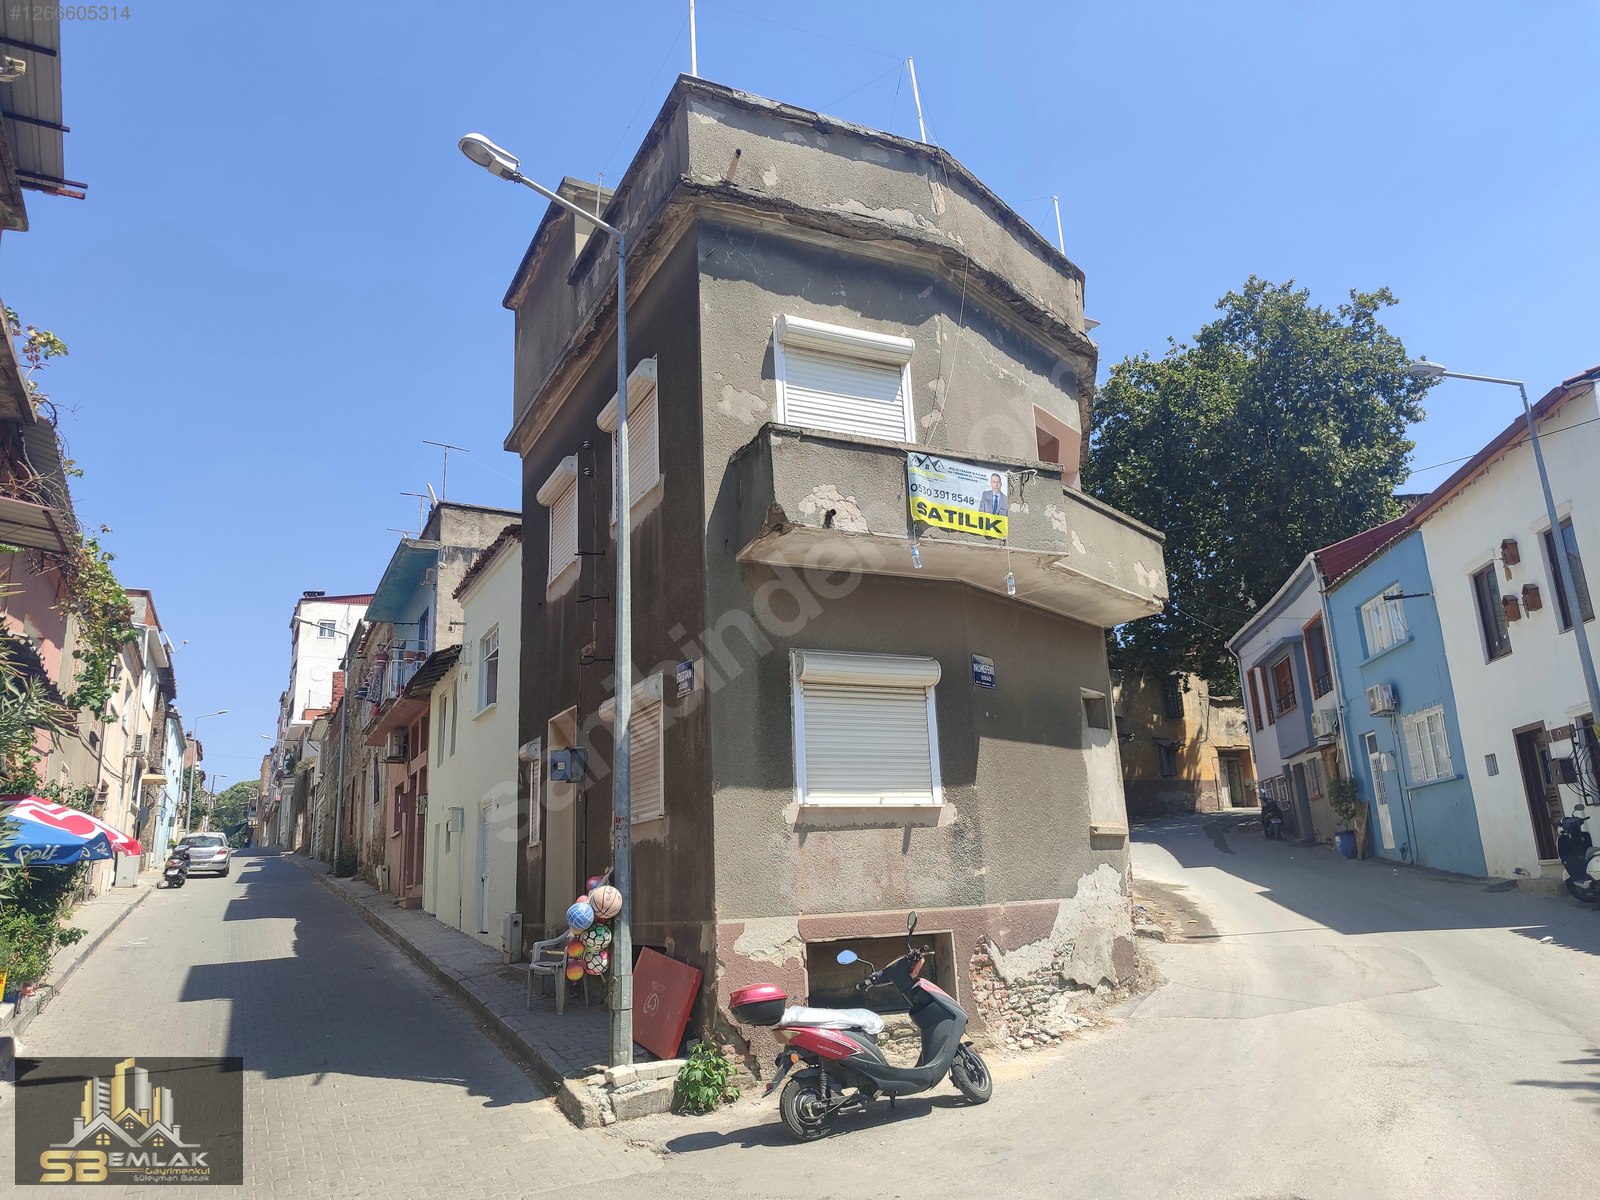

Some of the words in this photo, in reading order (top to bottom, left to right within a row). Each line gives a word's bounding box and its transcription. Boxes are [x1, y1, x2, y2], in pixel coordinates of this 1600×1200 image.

[933, 489, 950, 500] 391
[951, 493, 975, 506] 8548
[917, 502, 1002, 533] SATILIK
[14, 844, 60, 860] Golf
